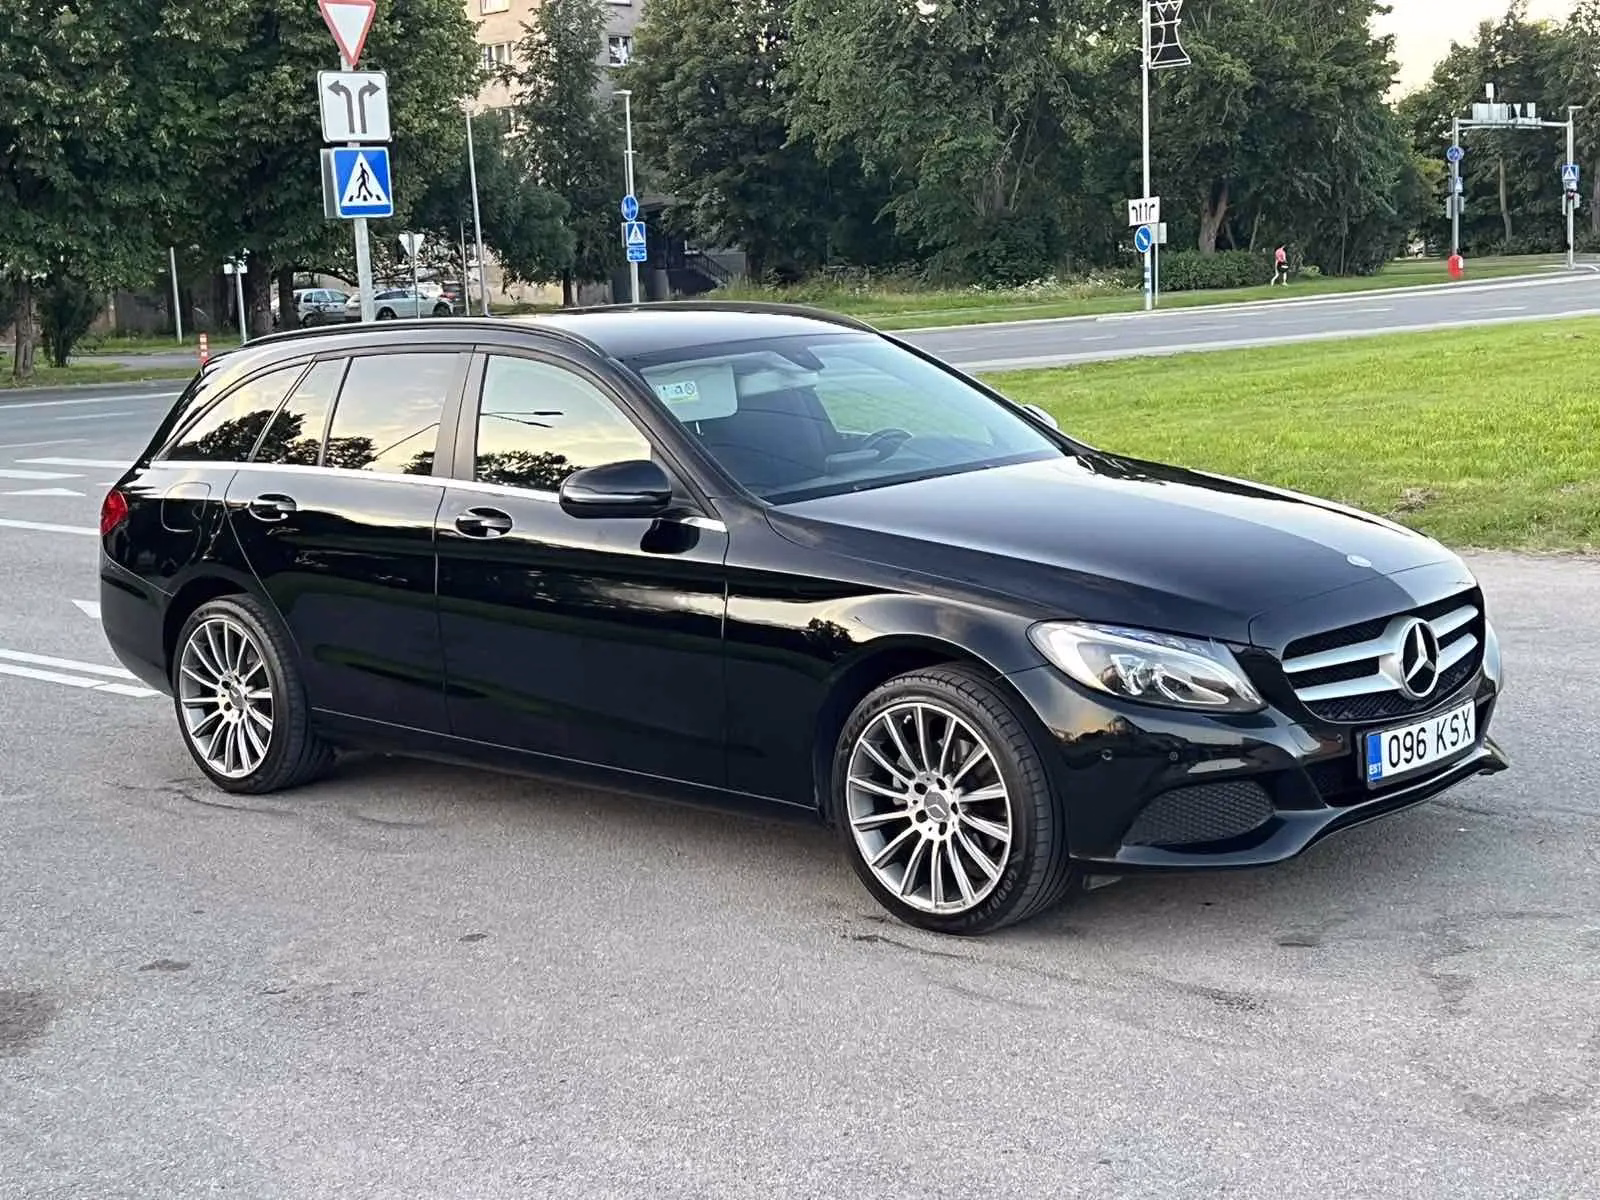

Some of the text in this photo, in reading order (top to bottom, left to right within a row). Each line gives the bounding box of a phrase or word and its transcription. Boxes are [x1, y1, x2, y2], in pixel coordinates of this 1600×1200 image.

[1388, 707, 1471, 768] 096 KSX
[1368, 763, 1381, 775] EST
